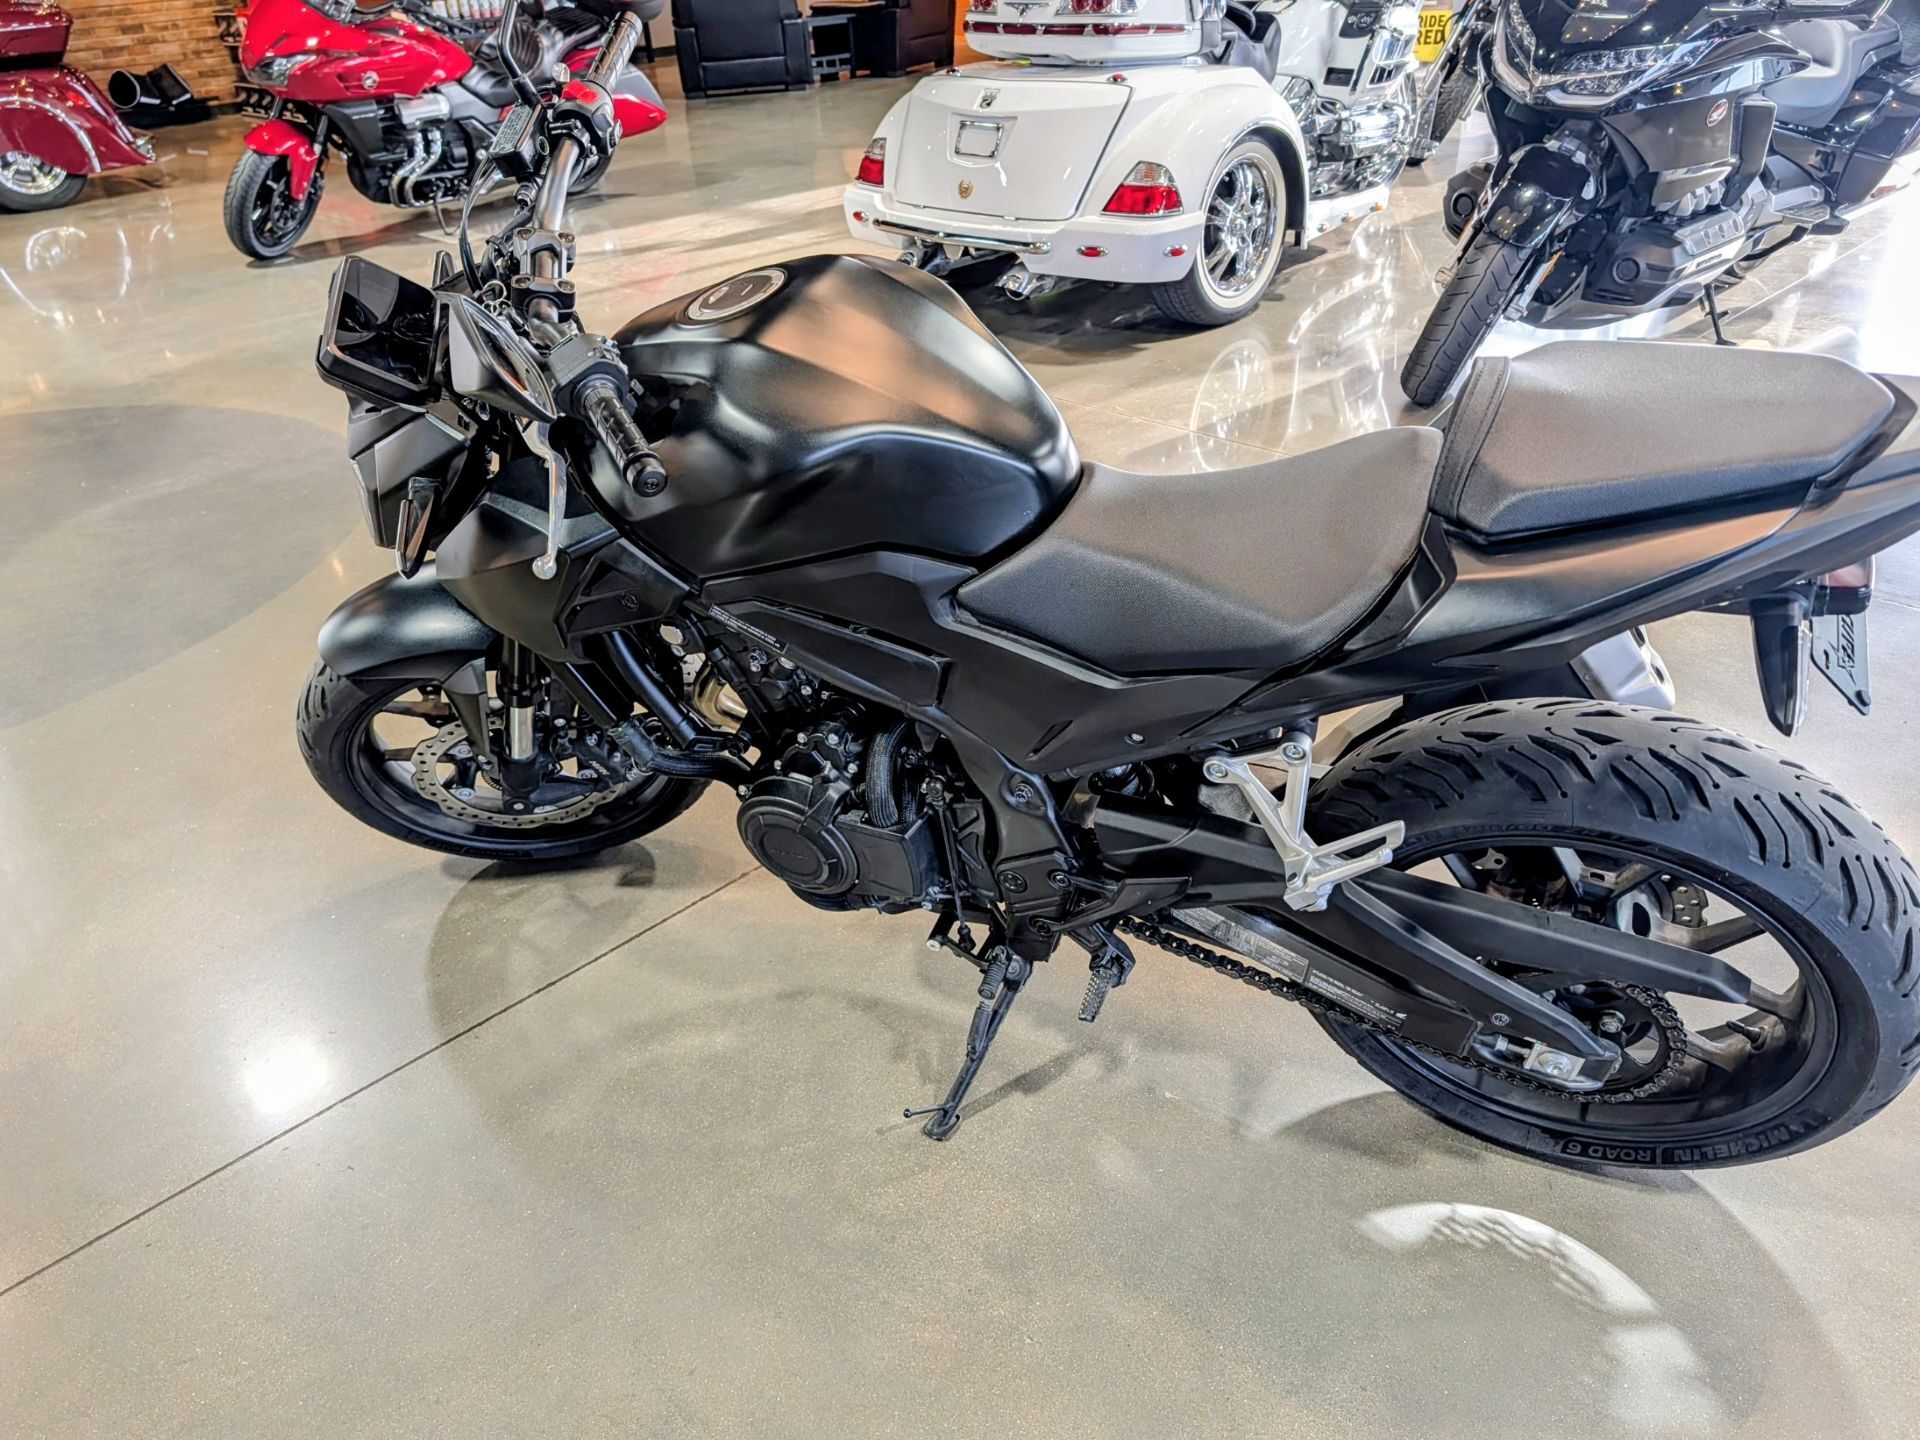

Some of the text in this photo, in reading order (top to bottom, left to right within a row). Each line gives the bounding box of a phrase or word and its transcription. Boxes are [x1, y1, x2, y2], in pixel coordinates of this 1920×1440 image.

[1418, 14, 1445, 28] RIDE
[1566, 1142, 1652, 1162] ROAD 6
[1674, 1125, 1790, 1162] MICHELIN
